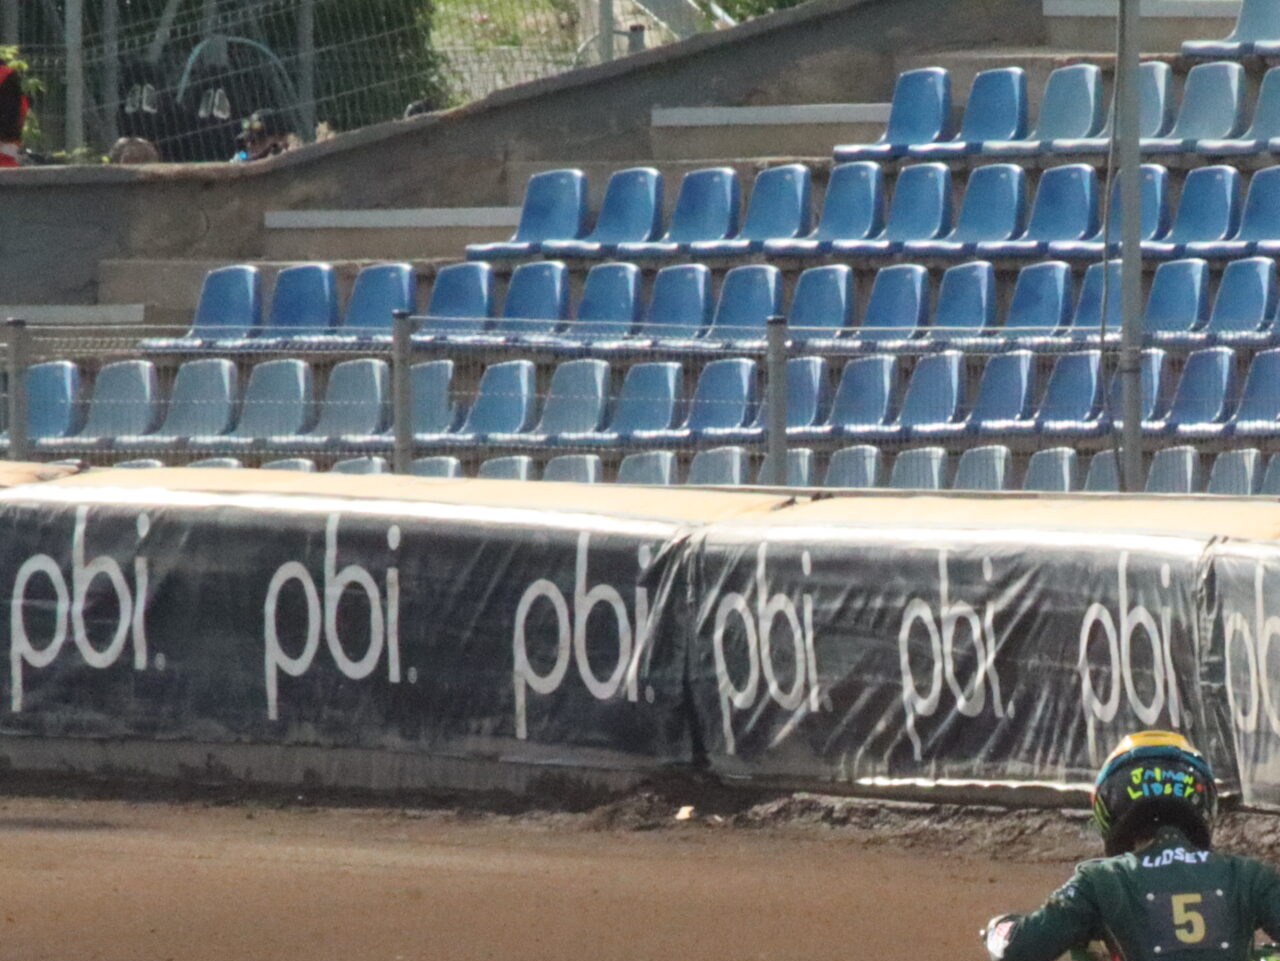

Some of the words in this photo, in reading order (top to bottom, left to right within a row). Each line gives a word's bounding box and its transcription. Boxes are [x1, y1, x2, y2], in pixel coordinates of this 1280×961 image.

[1126, 783, 1195, 800] LIDSEY
[1142, 847, 1210, 867] LIDSEY
[1171, 893, 1206, 944] 5
